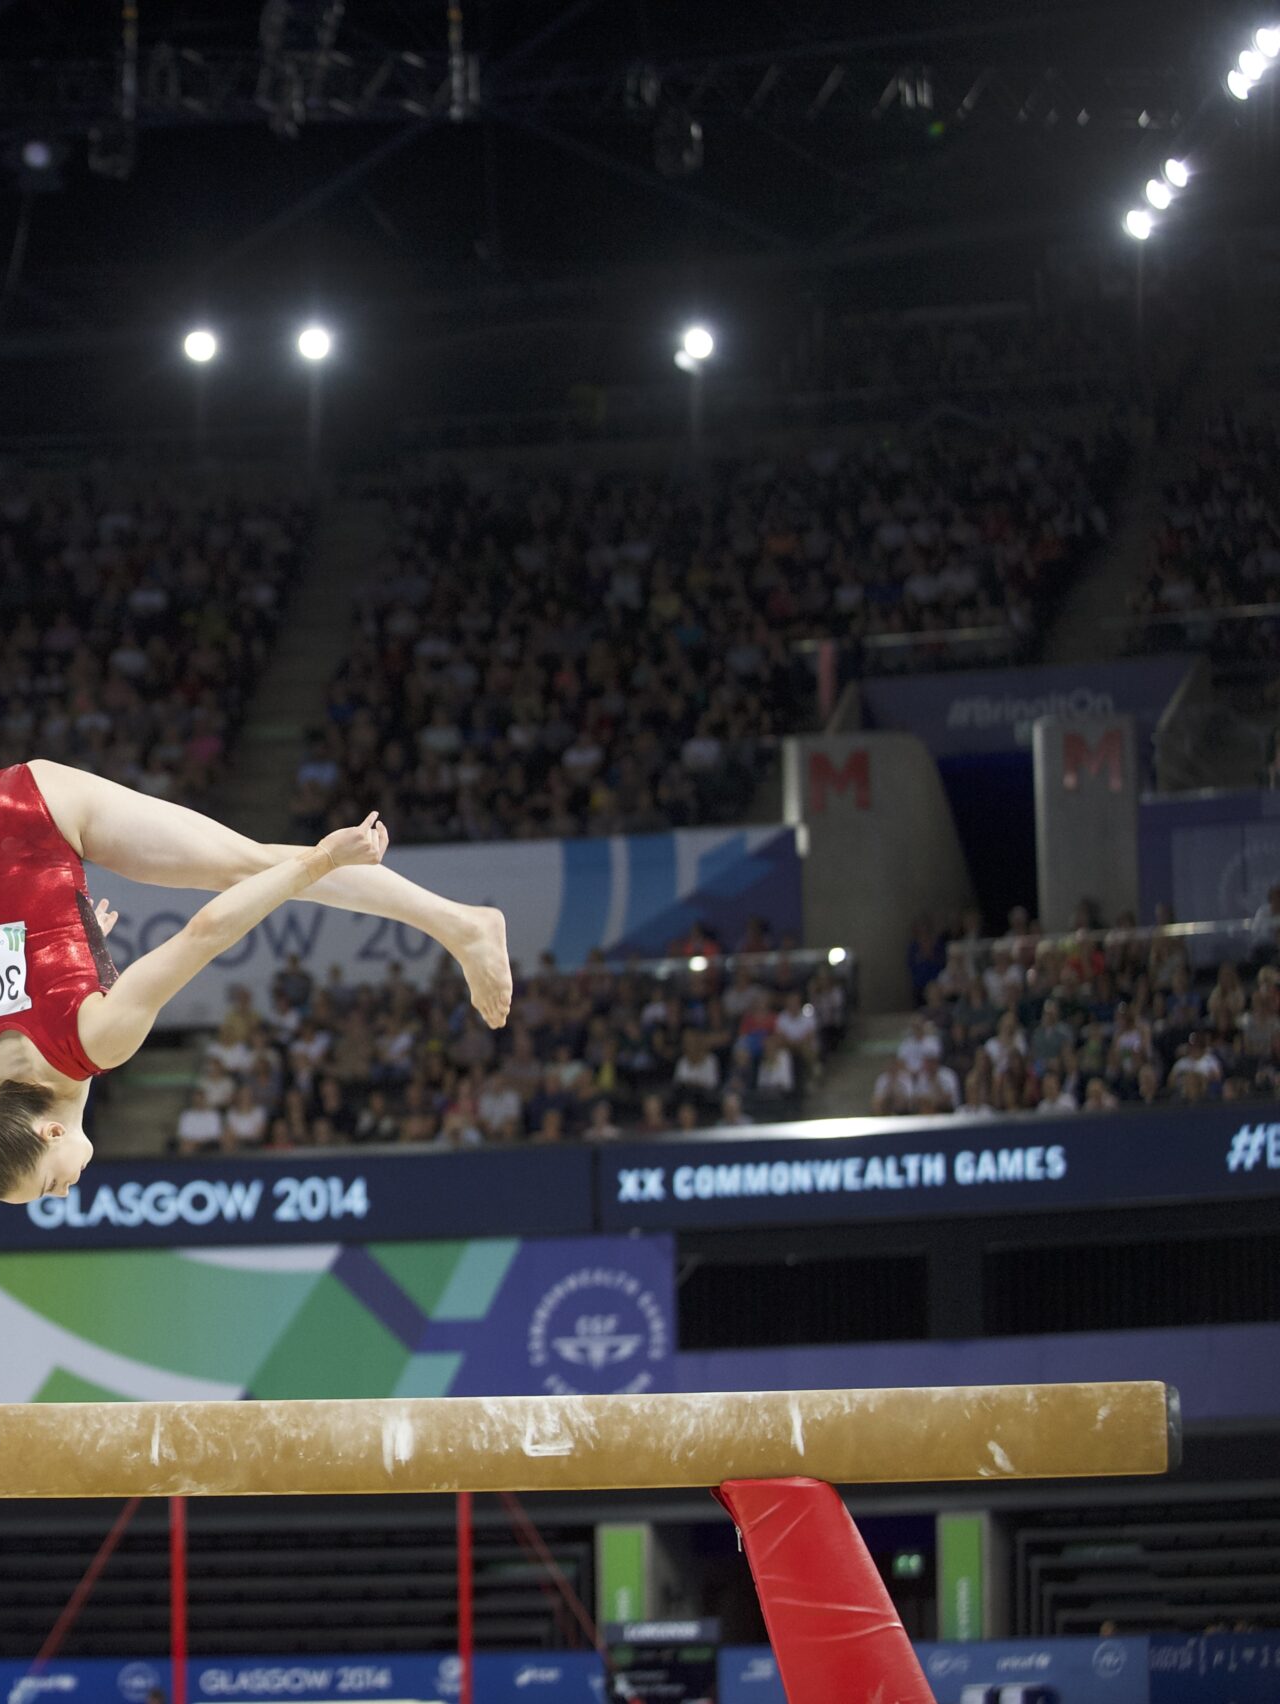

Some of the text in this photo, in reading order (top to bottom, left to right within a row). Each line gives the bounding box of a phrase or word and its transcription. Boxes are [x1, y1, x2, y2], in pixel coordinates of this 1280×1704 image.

[809, 749, 872, 812] M
[1062, 728, 1123, 791] M
[618, 1145, 1066, 1201] XX COMMONWEALTH GAMES
[26, 1175, 369, 1229] GLASGOW 2014
[199, 1667, 332, 1695] GLASGOW
